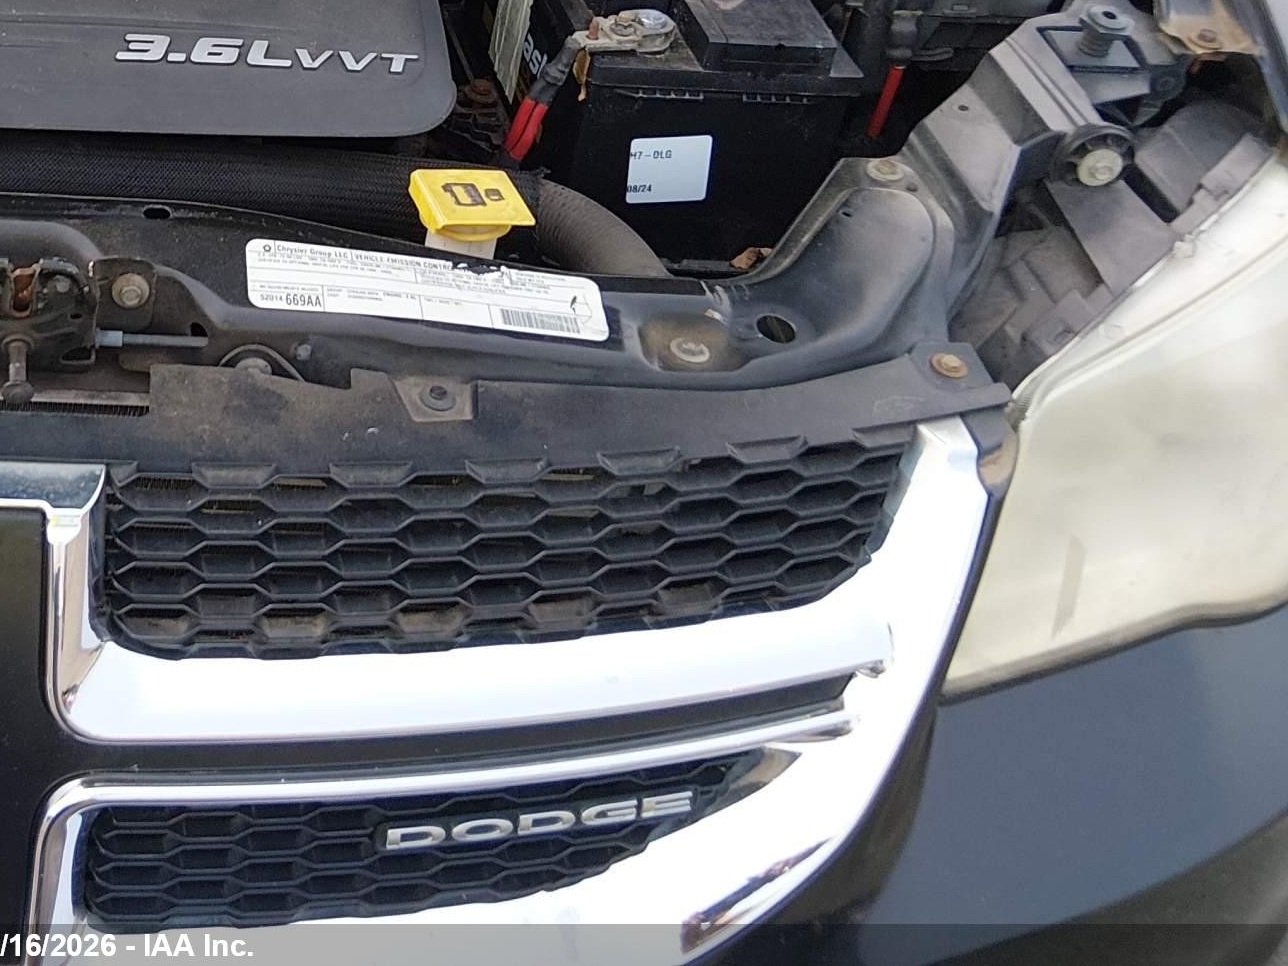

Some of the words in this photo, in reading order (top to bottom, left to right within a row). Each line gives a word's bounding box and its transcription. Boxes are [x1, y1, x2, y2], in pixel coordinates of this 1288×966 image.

[115, 32, 293, 69] 3.6L
[294, 47, 420, 74] VVT
[277, 244, 308, 255] Chrysler
[310, 247, 332, 258] Group
[334, 250, 348, 259] LLC
[355, 253, 384, 263] VEHICLE
[386, 257, 422, 267] EMISSION
[285, 292, 322, 308] 669AA
[385, 791, 693, 851] DODGE
